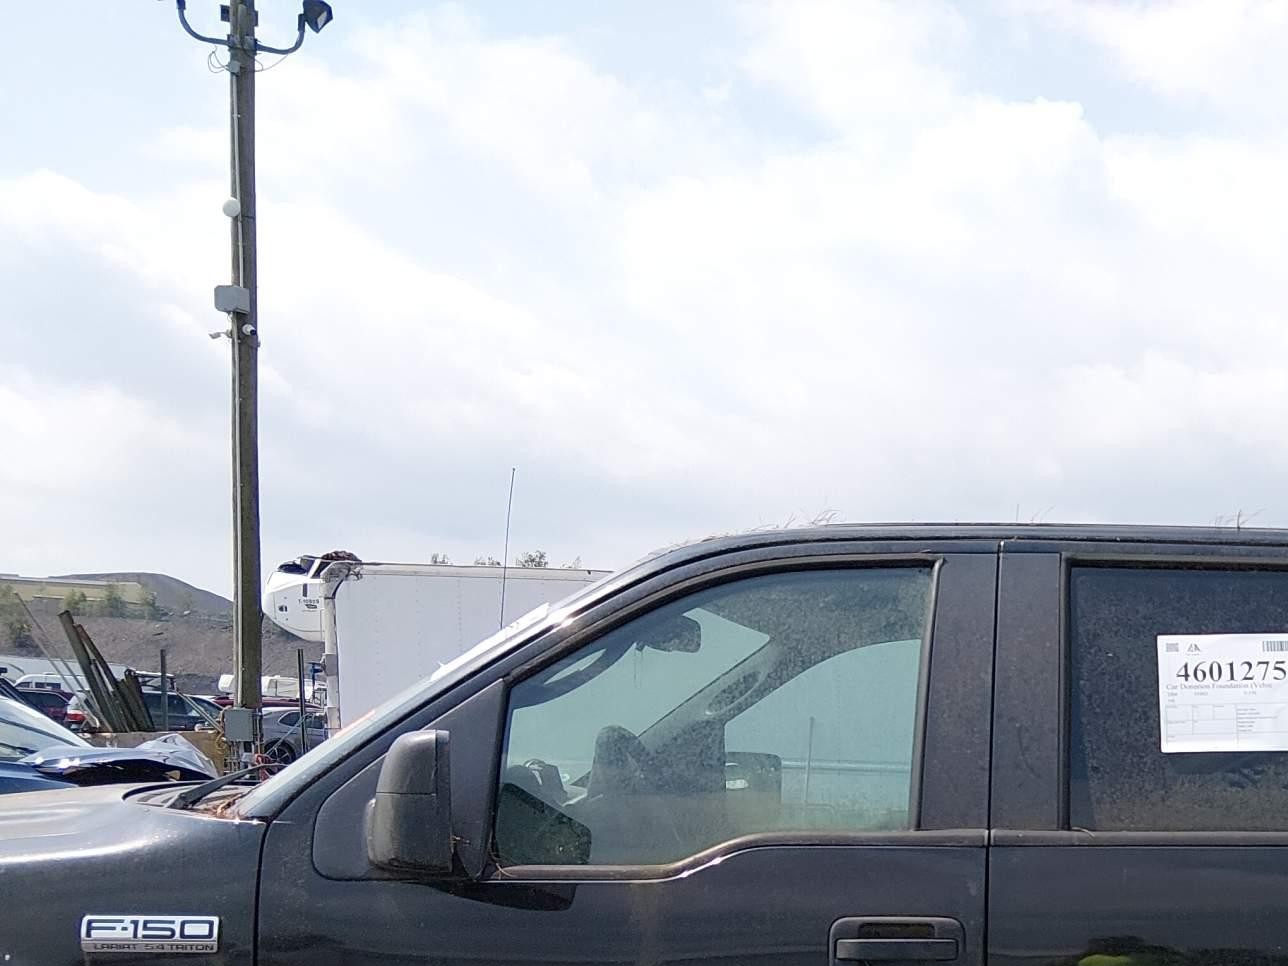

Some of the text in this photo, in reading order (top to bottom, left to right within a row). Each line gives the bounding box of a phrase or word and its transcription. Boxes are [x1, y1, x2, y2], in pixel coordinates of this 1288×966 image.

[1212, 682, 1249, 690] Foundation
[85, 918, 214, 940] F-150
[94, 943, 214, 951] LARIAT 5.4 TRITON
